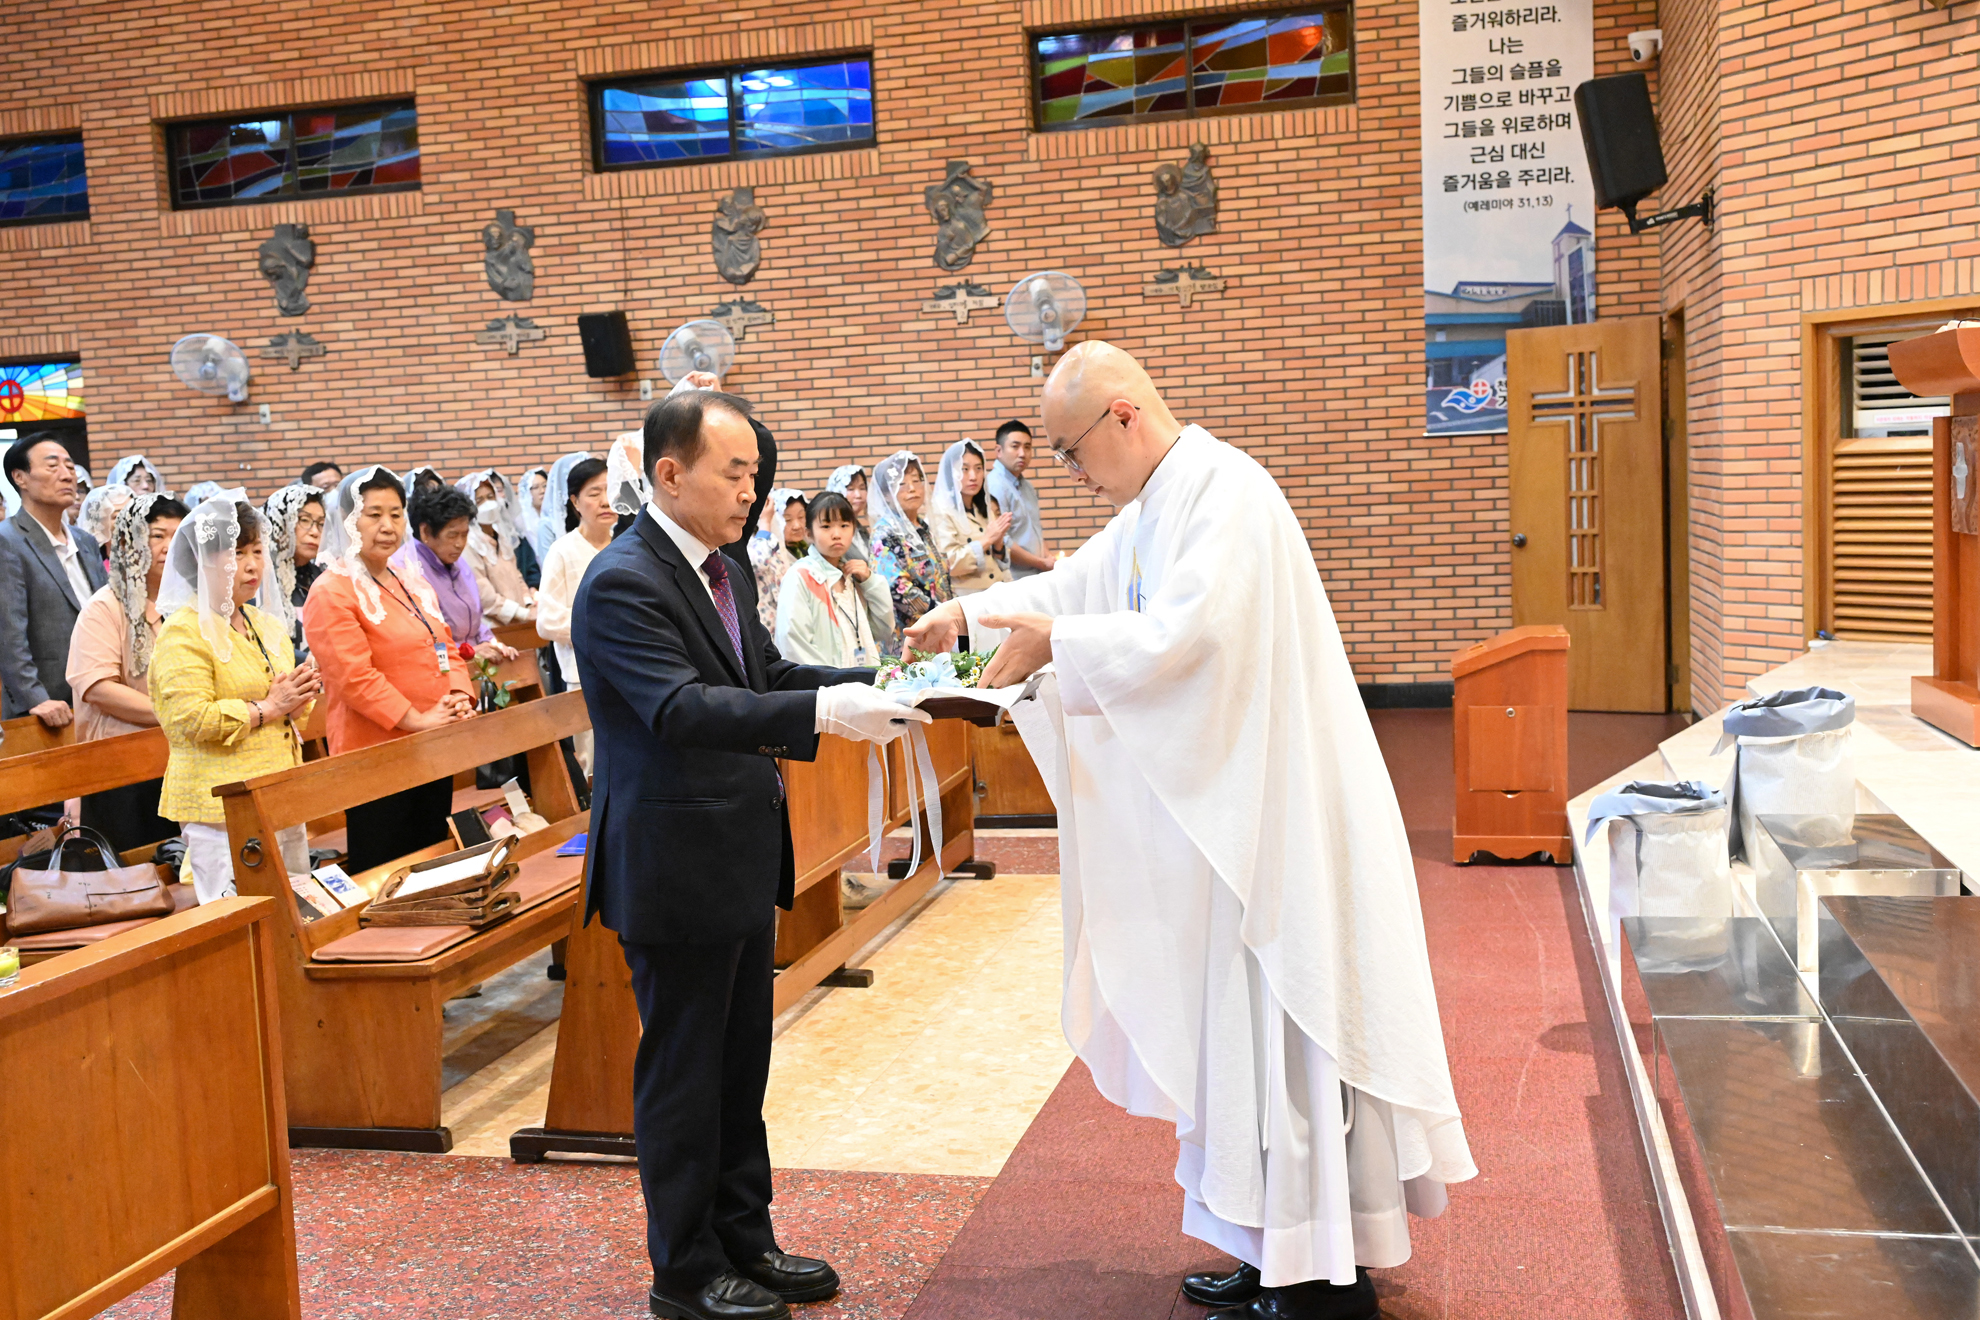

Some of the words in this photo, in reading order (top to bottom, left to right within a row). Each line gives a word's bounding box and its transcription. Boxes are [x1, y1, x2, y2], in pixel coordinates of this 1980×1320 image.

[1452, 5, 1561, 32] 즐거워하리라.
[1489, 37, 1523, 54] 나는
[1452, 64, 1503, 84] 그들의
[1510, 59, 1562, 80] 슬픔을
[1444, 91, 1513, 112] 기쁨으로
[1519, 86, 1571, 105] 바꾸고
[1444, 118, 1495, 138] 그들을
[1502, 112, 1571, 134] 위로하며
[1470, 145, 1504, 164] 근심
[1511, 141, 1545, 160] 대신
[1443, 170, 1512, 192] 즐거움을
[1518, 166, 1574, 186] 주리라.
[1463, 197, 1514, 213] (예레미야
